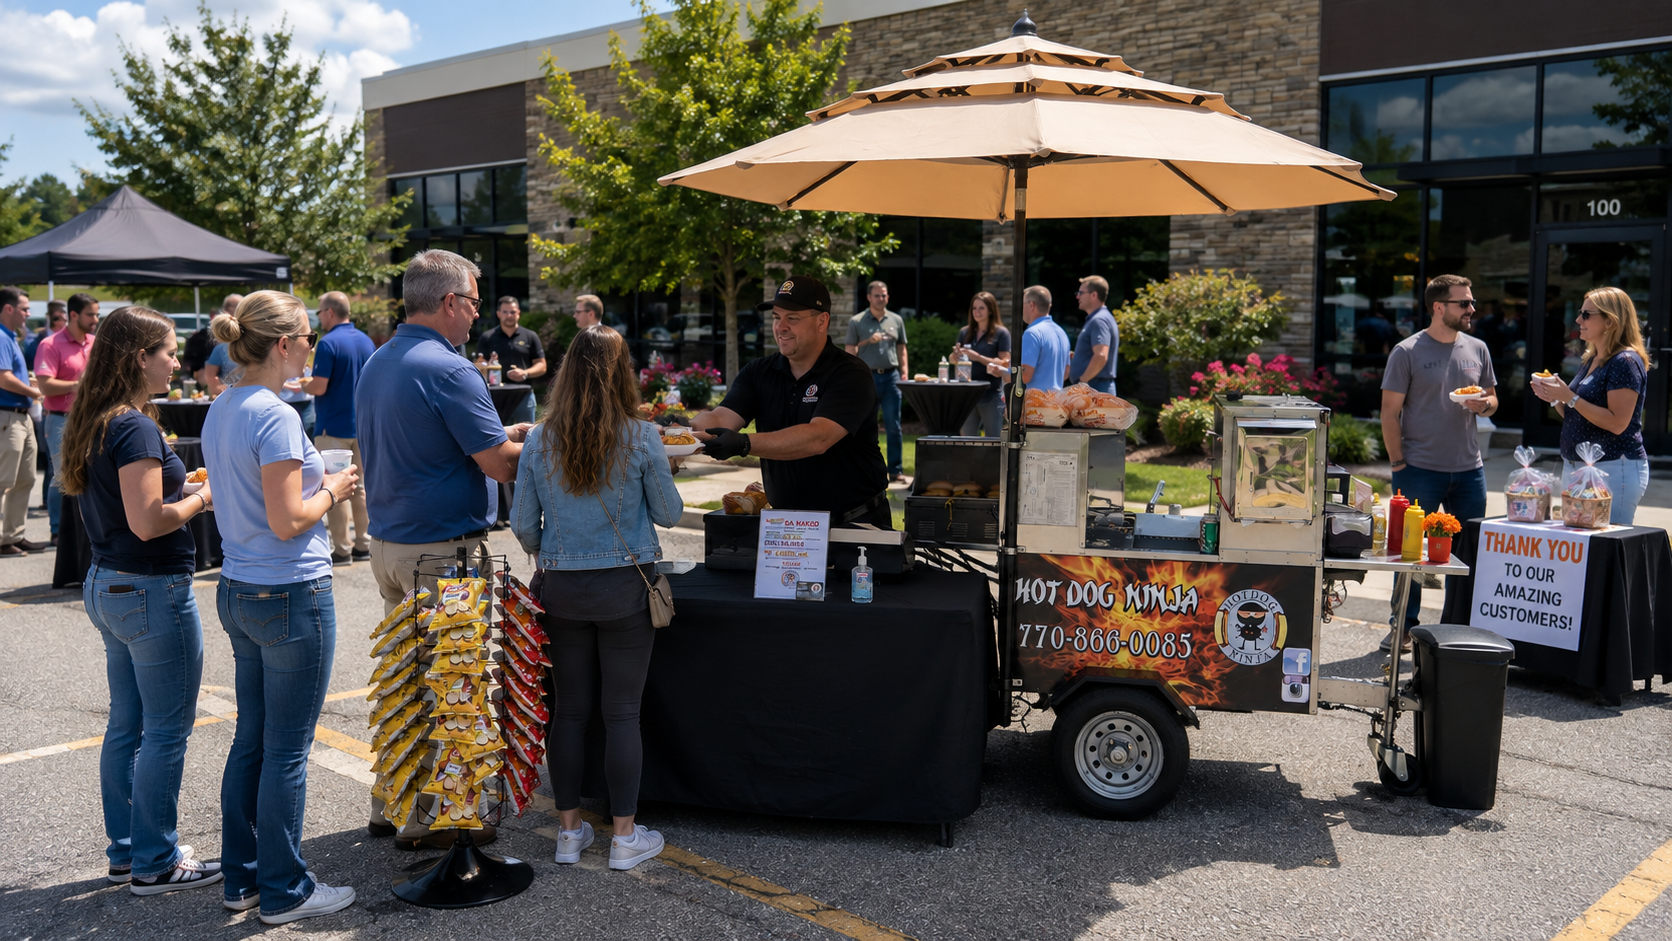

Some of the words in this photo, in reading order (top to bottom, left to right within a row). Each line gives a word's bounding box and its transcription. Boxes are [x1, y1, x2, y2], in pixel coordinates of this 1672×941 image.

[1586, 199, 1621, 216] 100
[1484, 530, 1543, 559] THANK
[1547, 538, 1584, 564] YOU
[1504, 562, 1522, 578] TO
[1526, 566, 1555, 583] OUR
[1015, 577, 1063, 606] HOT
[1066, 579, 1115, 610] DOG
[1125, 580, 1199, 615] NINJA
[1494, 582, 1562, 607] AMAZING
[1480, 602, 1573, 631] CUSTOMERS!
[1019, 623, 1193, 659] 770-866-0085
[1229, 649, 1272, 664] NINJA
